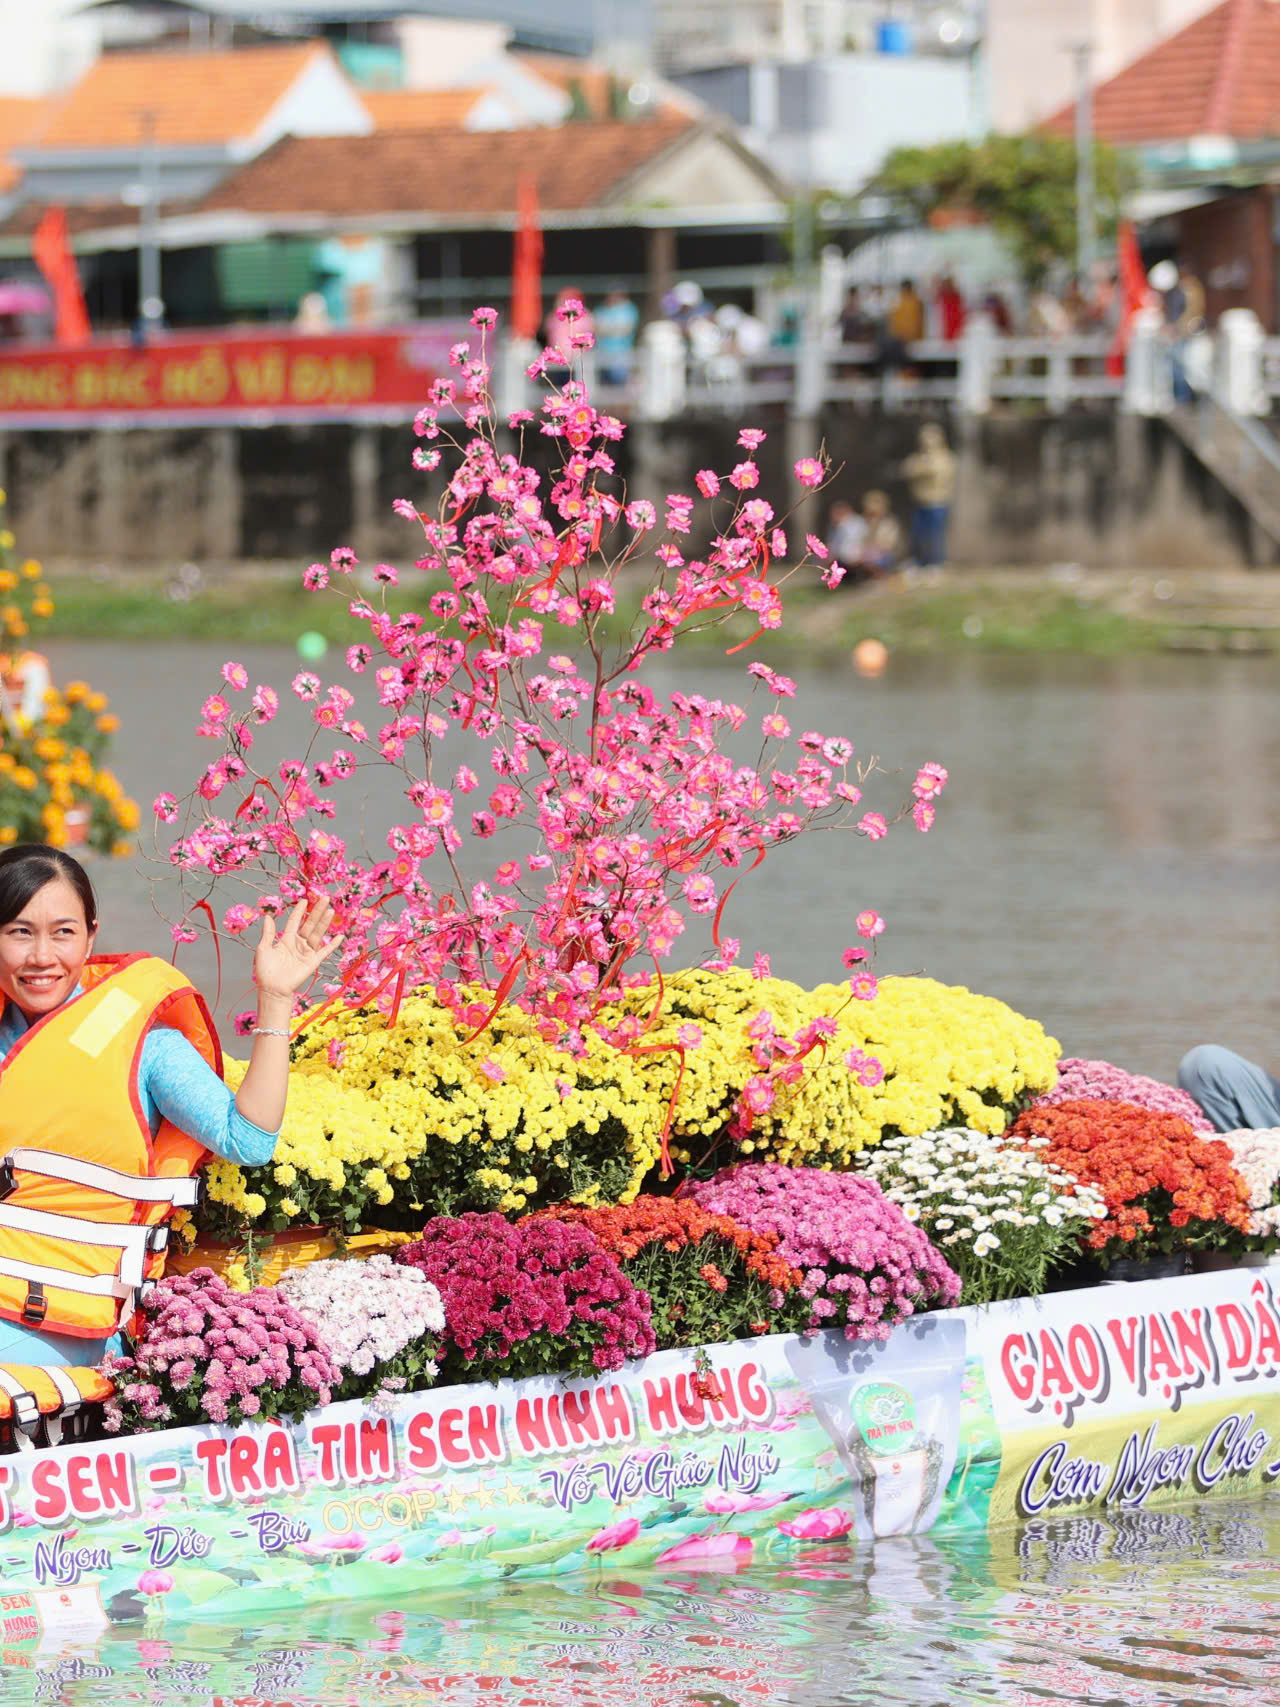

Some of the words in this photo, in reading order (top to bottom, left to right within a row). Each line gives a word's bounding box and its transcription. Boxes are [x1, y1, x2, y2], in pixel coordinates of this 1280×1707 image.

[1001, 1324, 1100, 1415] GẠO
[1107, 1308, 1211, 1399] VẠN
[1215, 1279, 1280, 1370] DÂ
[32, 1452, 131, 1518] SEN
[312, 1419, 390, 1482] TIM
[408, 1405, 502, 1468] SEN
[516, 1385, 631, 1451] NINH
[592, 1455, 641, 1502] Về
[645, 1452, 709, 1499] Giấc
[720, 1437, 776, 1492] Ngủ
[1023, 1442, 1102, 1511] Cơm
[1108, 1422, 1195, 1505] Ngon
[1200, 1414, 1267, 1481] Cho
[35, 1534, 107, 1584] Ngon
[144, 1524, 209, 1566] Dẻo
[248, 1510, 308, 1549] Bùi
[322, 1489, 437, 1535] OCOP
[0, 1594, 32, 1610] SEN
